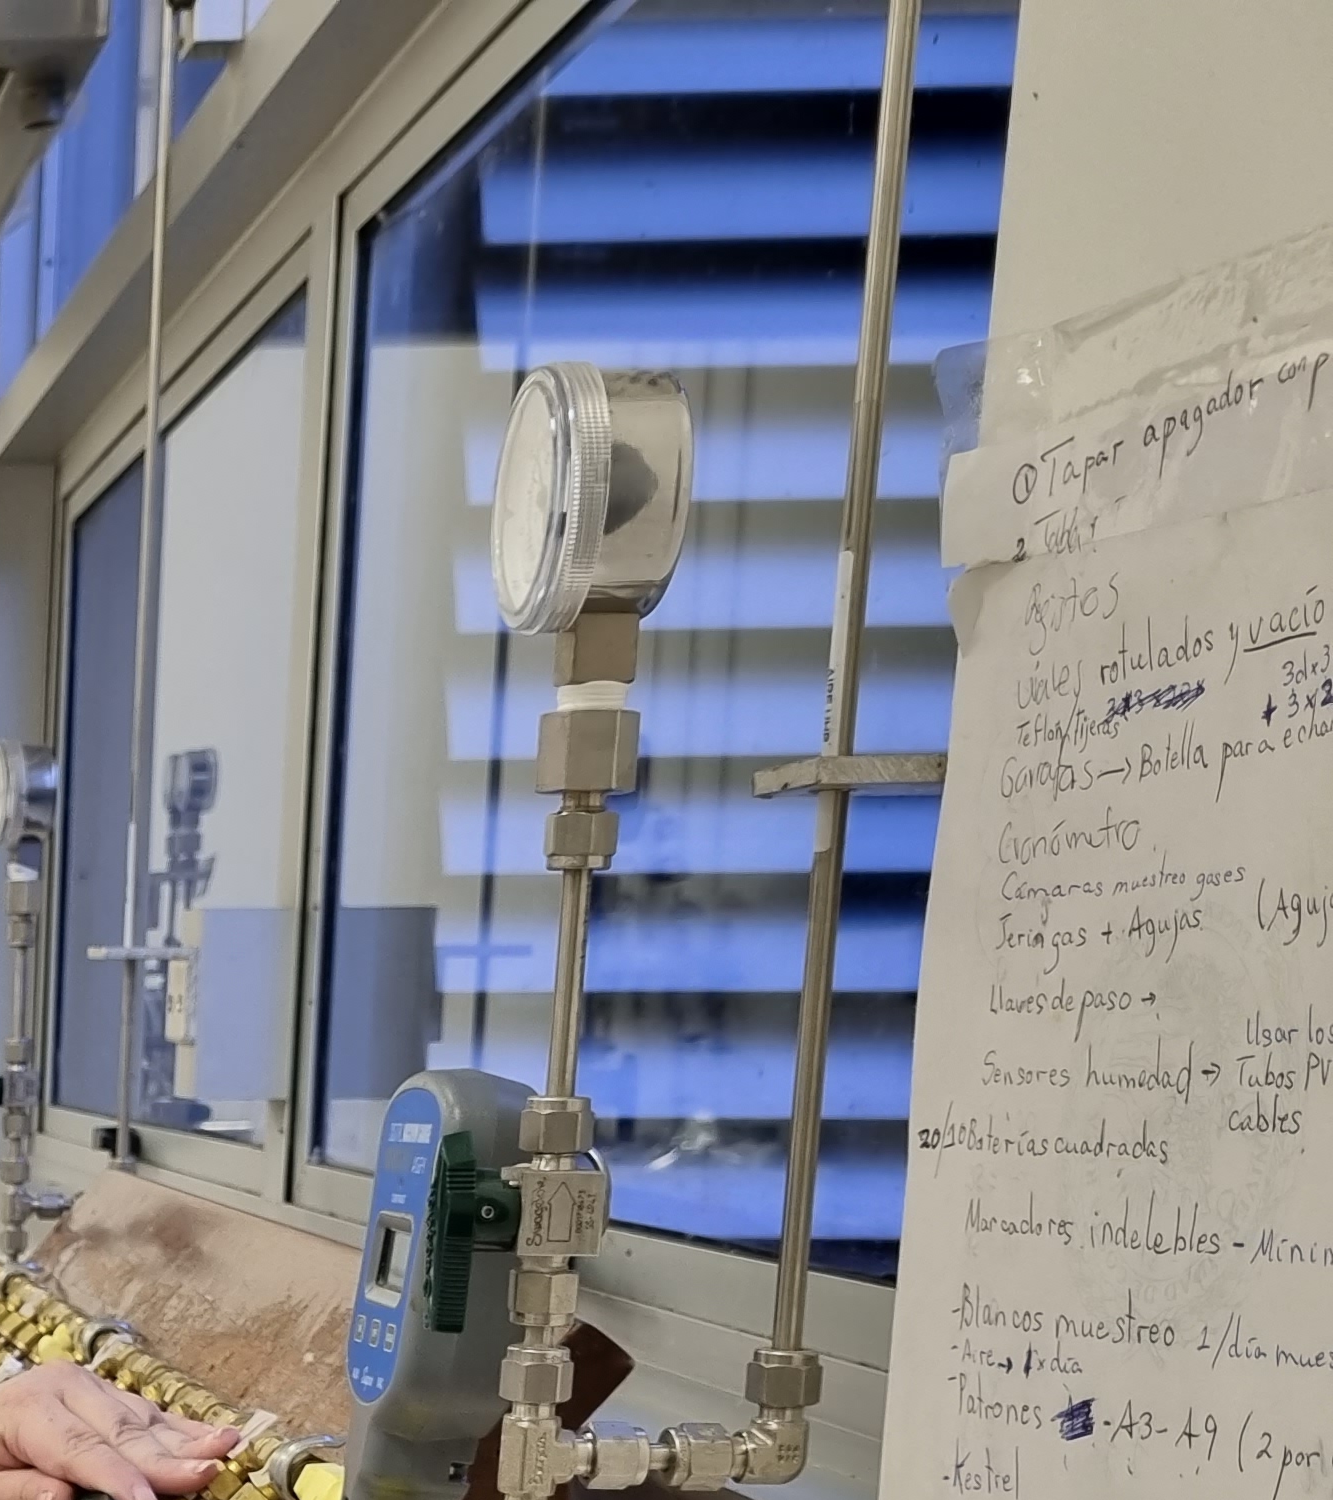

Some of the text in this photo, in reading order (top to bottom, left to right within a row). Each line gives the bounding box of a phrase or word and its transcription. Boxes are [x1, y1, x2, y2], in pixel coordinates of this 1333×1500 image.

[1041, 436, 1123, 497] Tapar
[1143, 369, 1264, 480] apagador
[1278, 356, 1307, 384] con
[1100, 615, 1214, 685] rotulados
[1224, 622, 1240, 685] y
[1139, 717, 1210, 783] Botella
[1214, 738, 1276, 804] para
[1112, 849, 1186, 897] muestreo
[1190, 865, 1246, 902] gases
[989, 977, 1133, 1042] Llaves de paso
[981, 1050, 1071, 1088] Sensores
[1085, 1034, 1194, 1105] humedad
[1236, 1051, 1296, 1091] Tubos
[1053, 1118, 1169, 1165] cuadradas
[1228, 1091, 1303, 1135] cables
[965, 1190, 1075, 1246] Marcadores
[1089, 1189, 1221, 1256] indelebles
[1054, 1287, 1176, 1347] muestreo
